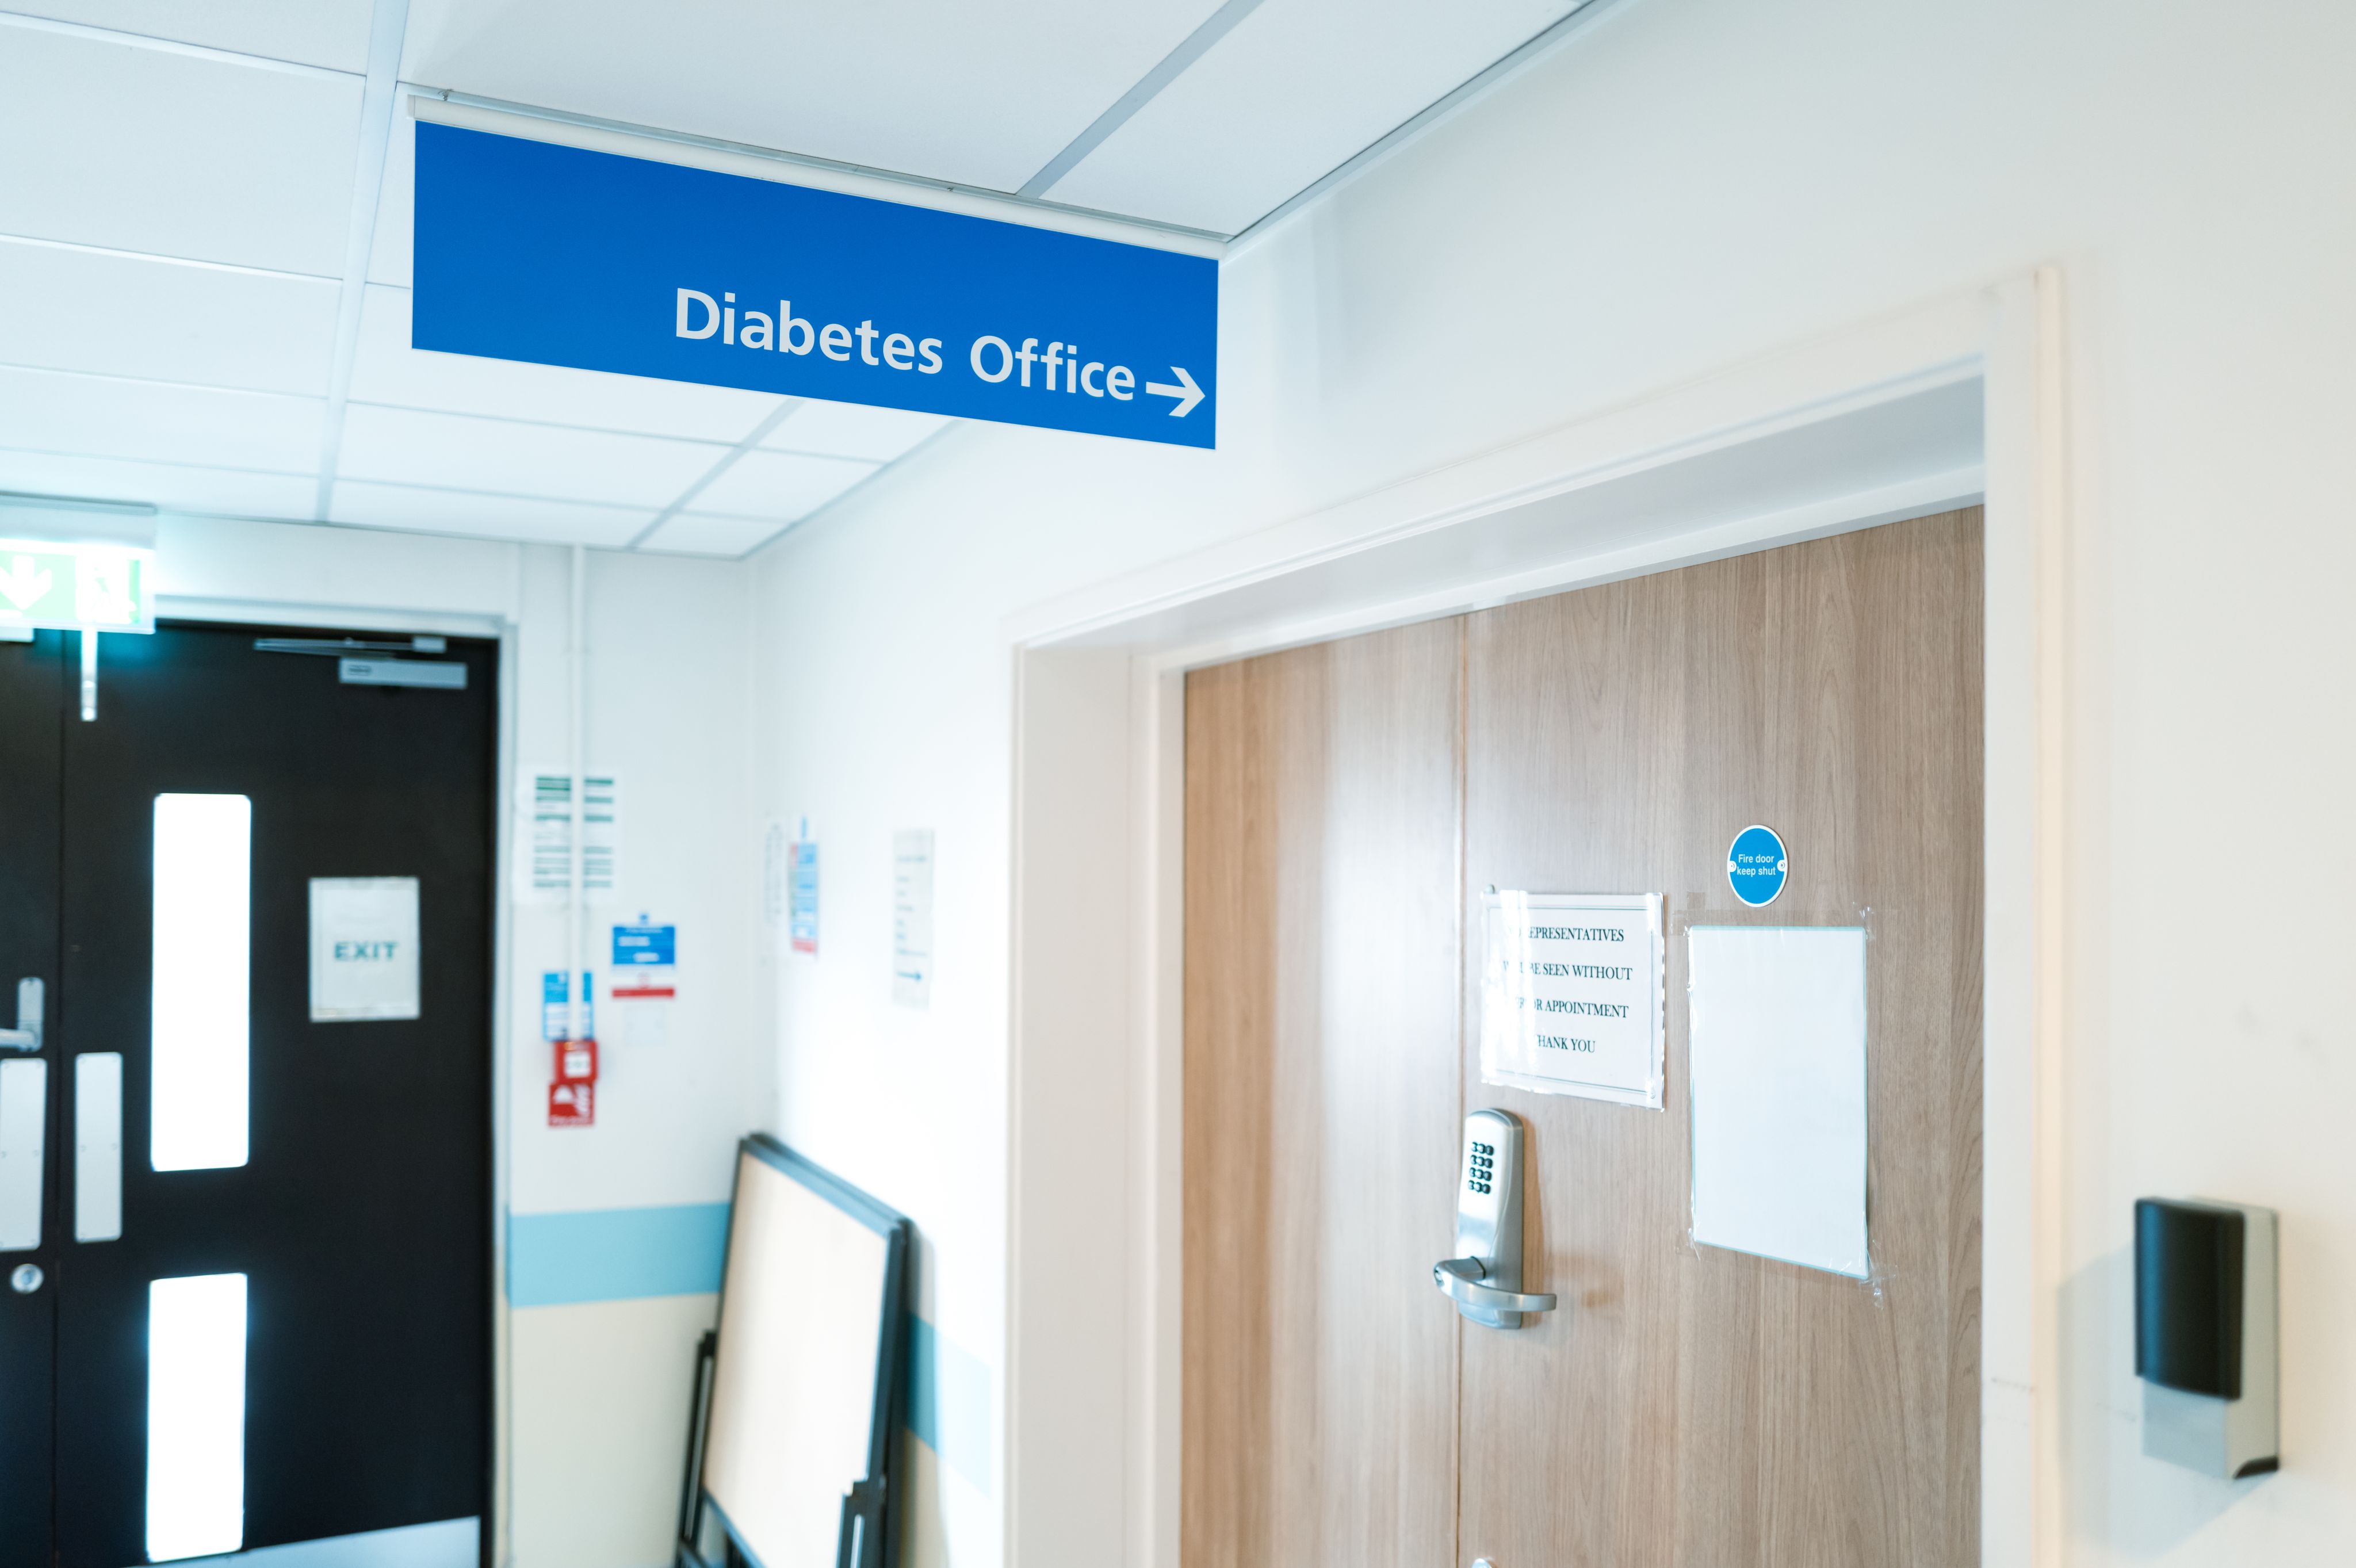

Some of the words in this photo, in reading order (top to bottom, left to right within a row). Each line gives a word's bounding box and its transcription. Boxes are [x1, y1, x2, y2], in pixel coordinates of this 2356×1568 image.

[676, 288, 943, 374] Diabetes
[970, 335, 1135, 401] Office
[1738, 854, 1753, 863] Fire
[1755, 854, 1774, 863] door
[1737, 866, 1756, 878] keep
[1758, 866, 1776, 875] shut
[1527, 926, 1624, 942] EPRESENTATIVES
[334, 940, 400, 962] EXIT
[1543, 962, 1570, 977] SEEN
[1572, 965, 1633, 980] WITHOUT
[1545, 999, 1629, 1018] APPOINTMENT
[1571, 1038, 1596, 1053] YOU
